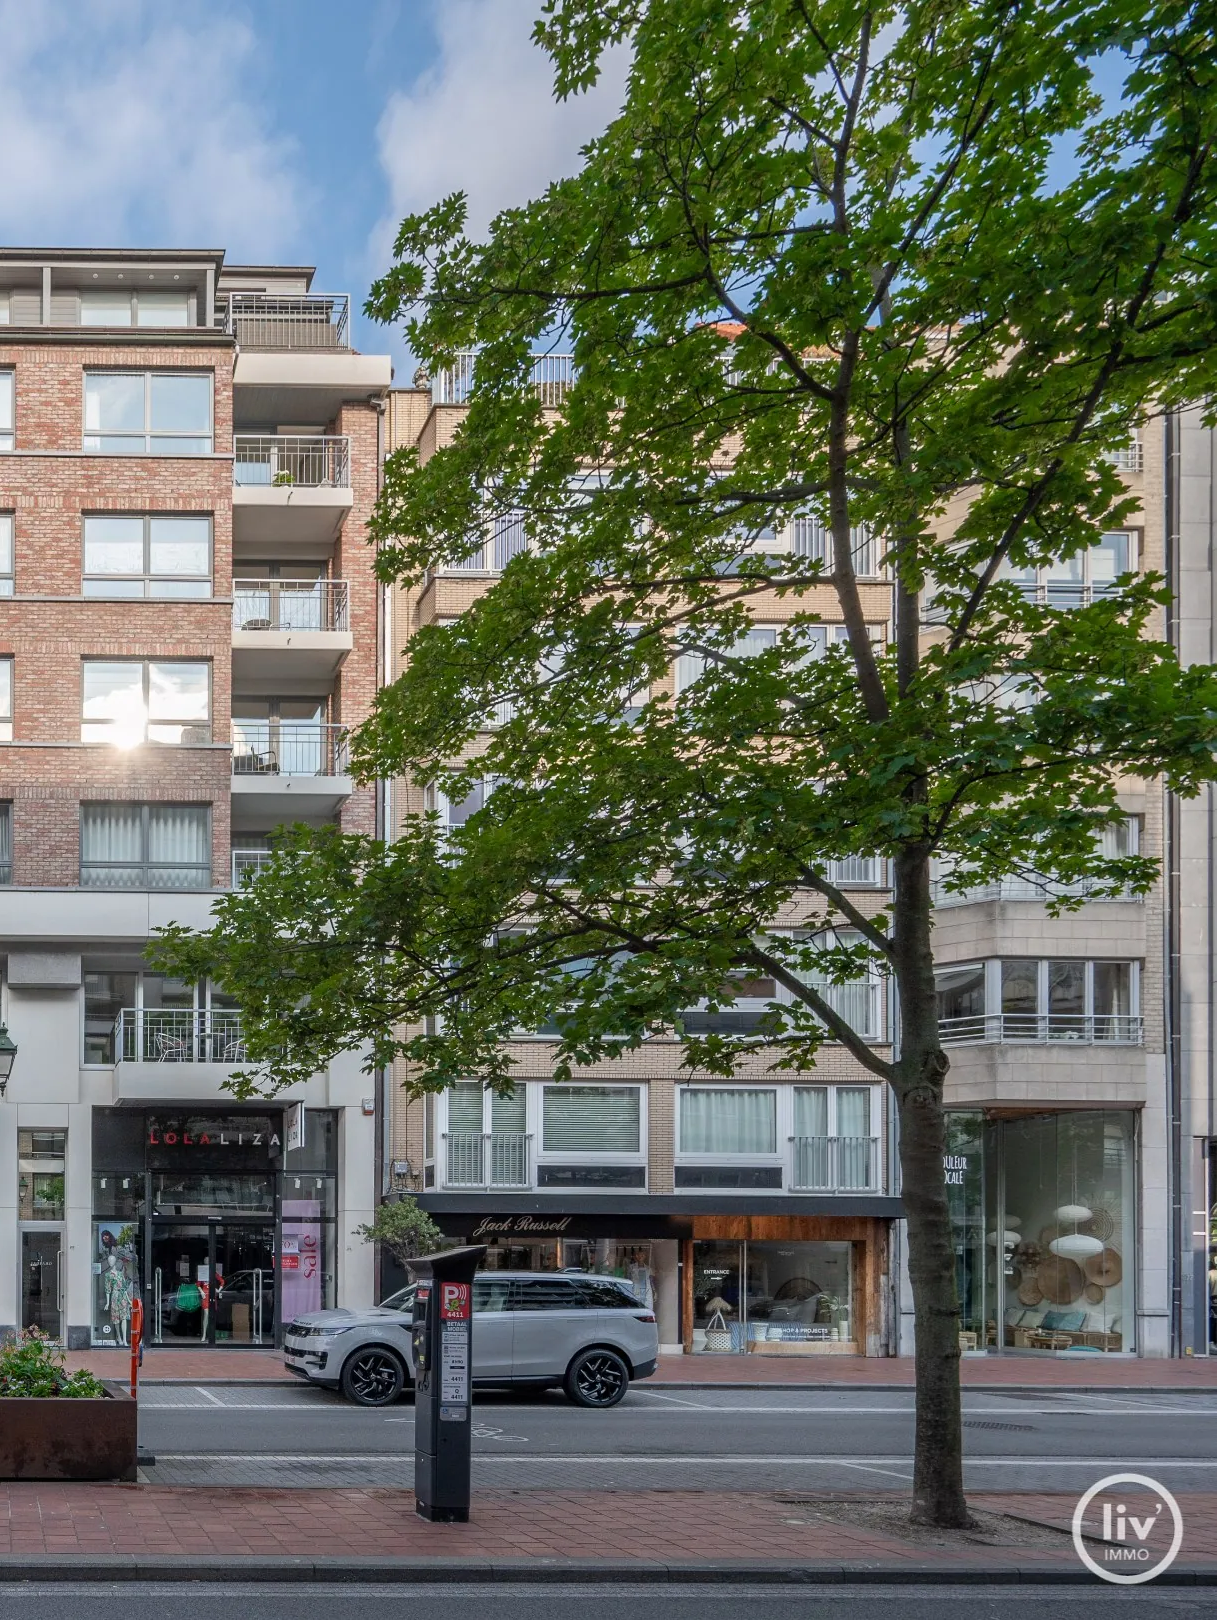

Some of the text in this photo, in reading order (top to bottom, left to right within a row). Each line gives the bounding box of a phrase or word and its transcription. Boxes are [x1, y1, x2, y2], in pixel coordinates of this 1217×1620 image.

[473, 1215, 572, 1236] Jack Russell
[299, 1234, 317, 1279] sale
[444, 1286, 459, 1304] P
